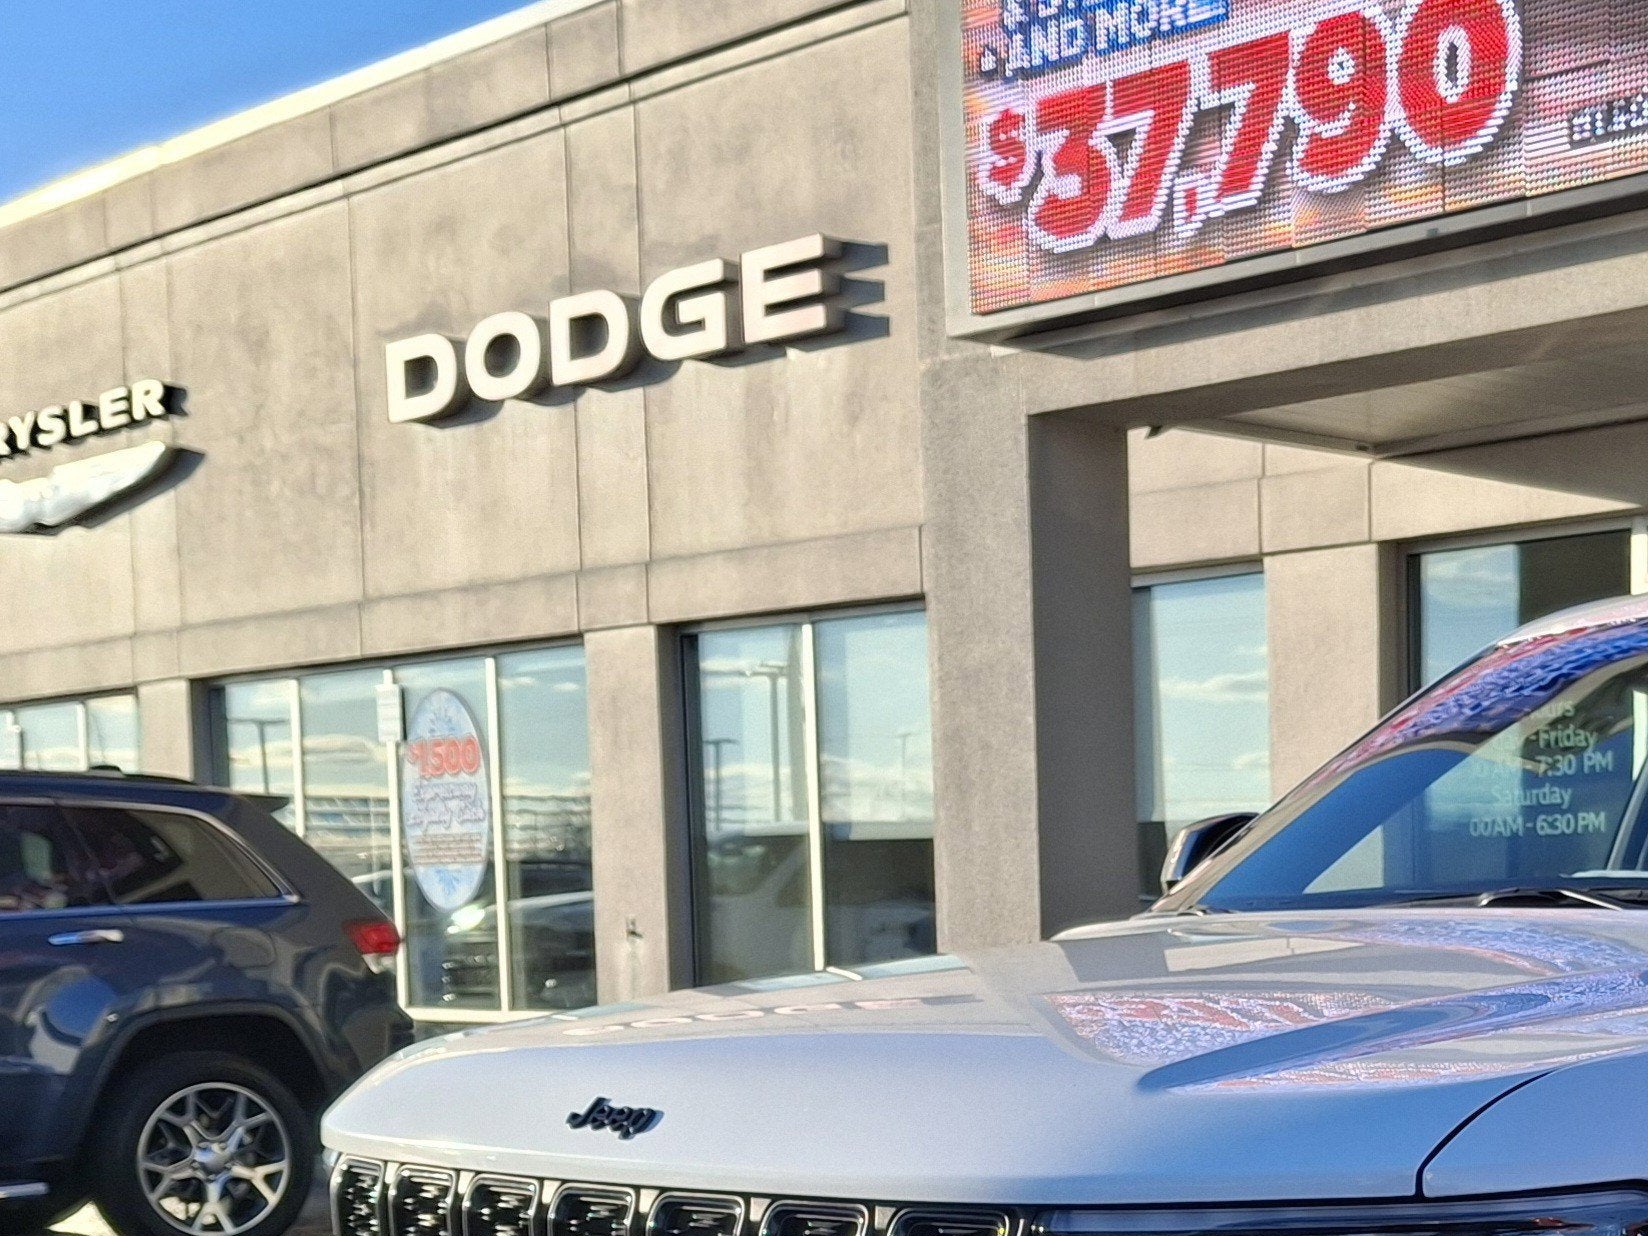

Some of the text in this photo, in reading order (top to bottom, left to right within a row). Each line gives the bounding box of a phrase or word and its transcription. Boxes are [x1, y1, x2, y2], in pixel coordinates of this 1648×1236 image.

[979, 0, 1524, 253] $37,790
[386, 232, 832, 424] DODGE
[1538, 724, 1597, 748] Friday
[1583, 750, 1613, 774] PM
[1493, 783, 1571, 808] Saturday
[1577, 811, 1606, 834] PM
[565, 1096, 663, 1140] Jeep
